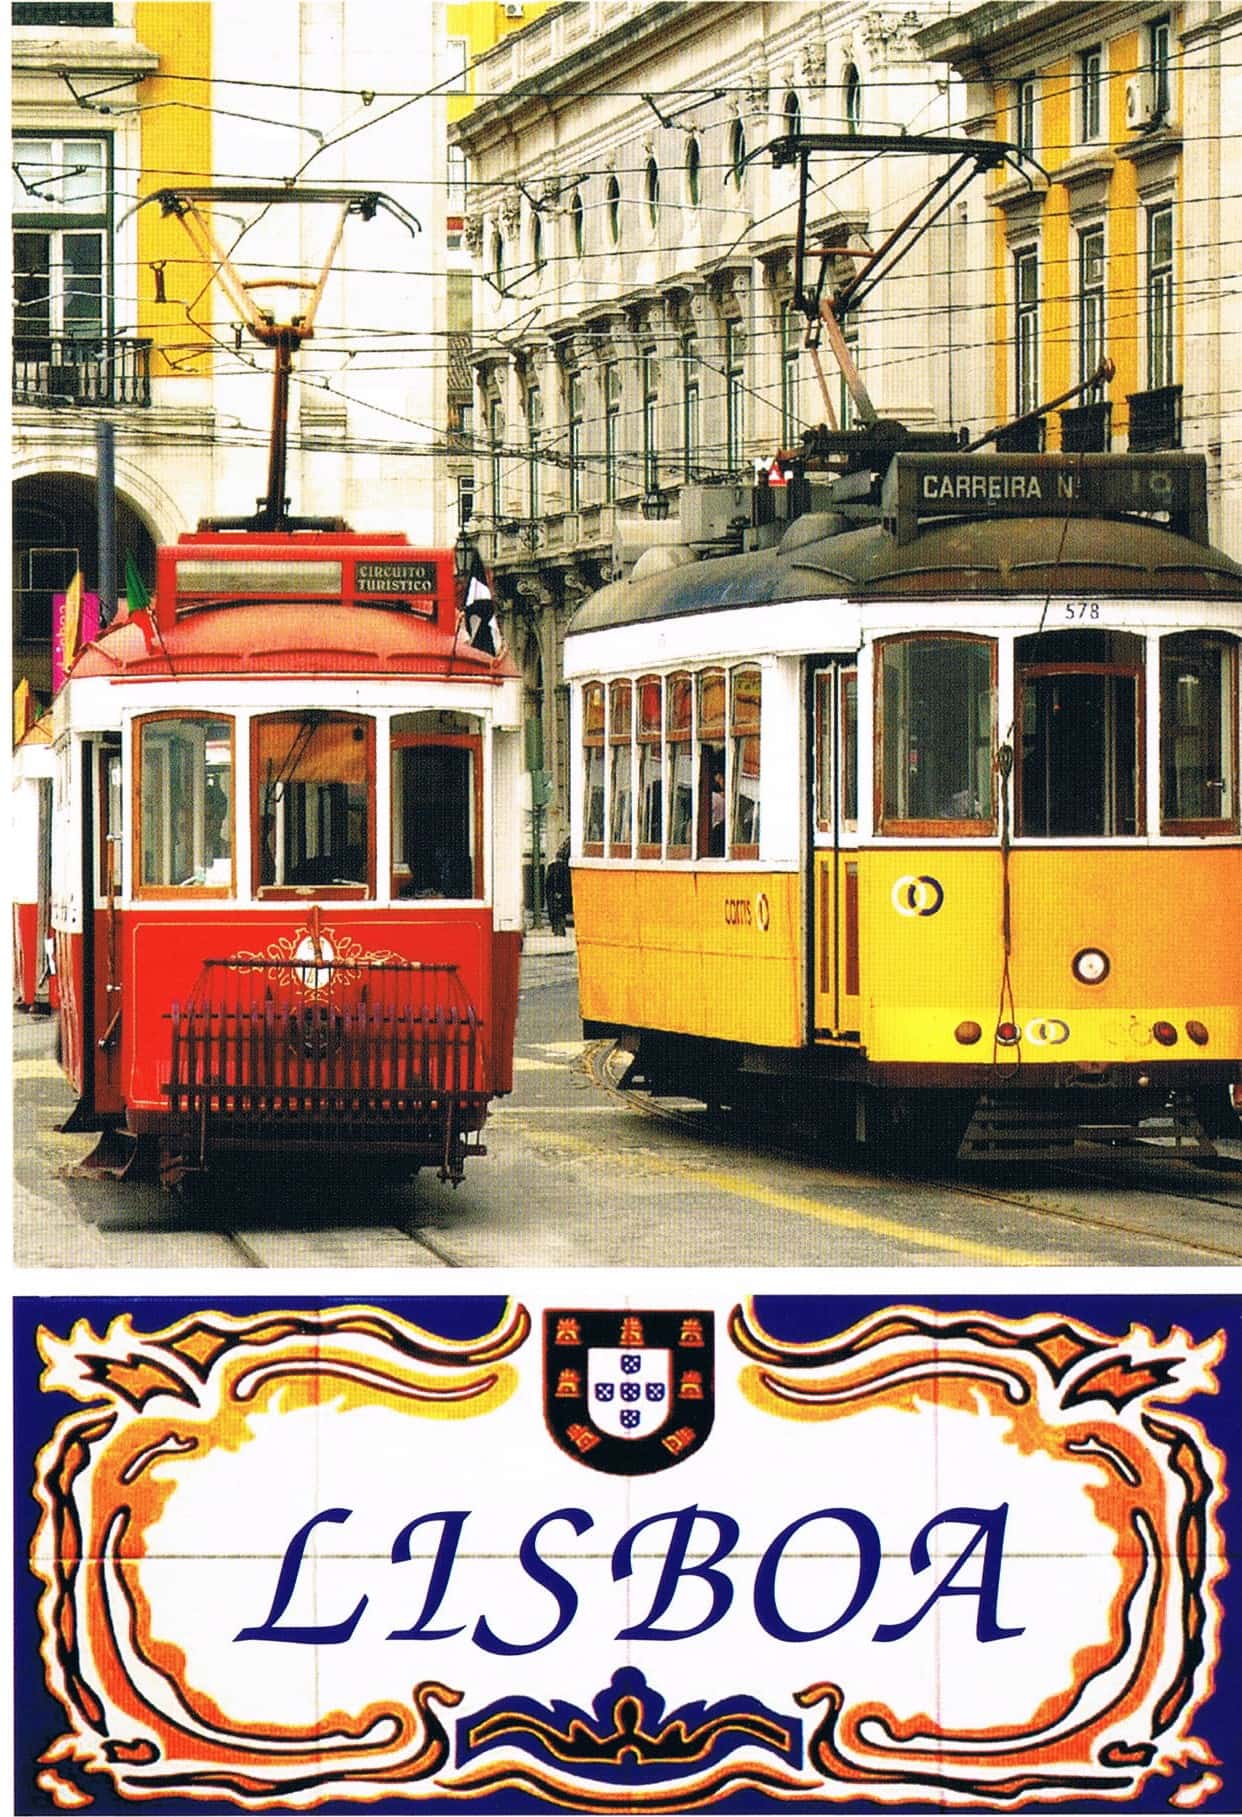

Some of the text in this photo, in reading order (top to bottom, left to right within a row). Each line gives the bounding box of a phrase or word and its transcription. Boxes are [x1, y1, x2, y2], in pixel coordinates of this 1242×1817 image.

[924, 475, 1041, 499] CARREIRA
[359, 566, 426, 577] CIRCUITO
[357, 579, 432, 592] TURISTICO
[1065, 602, 1100, 620] 578
[235, 1503, 1026, 1656] LISBOA
